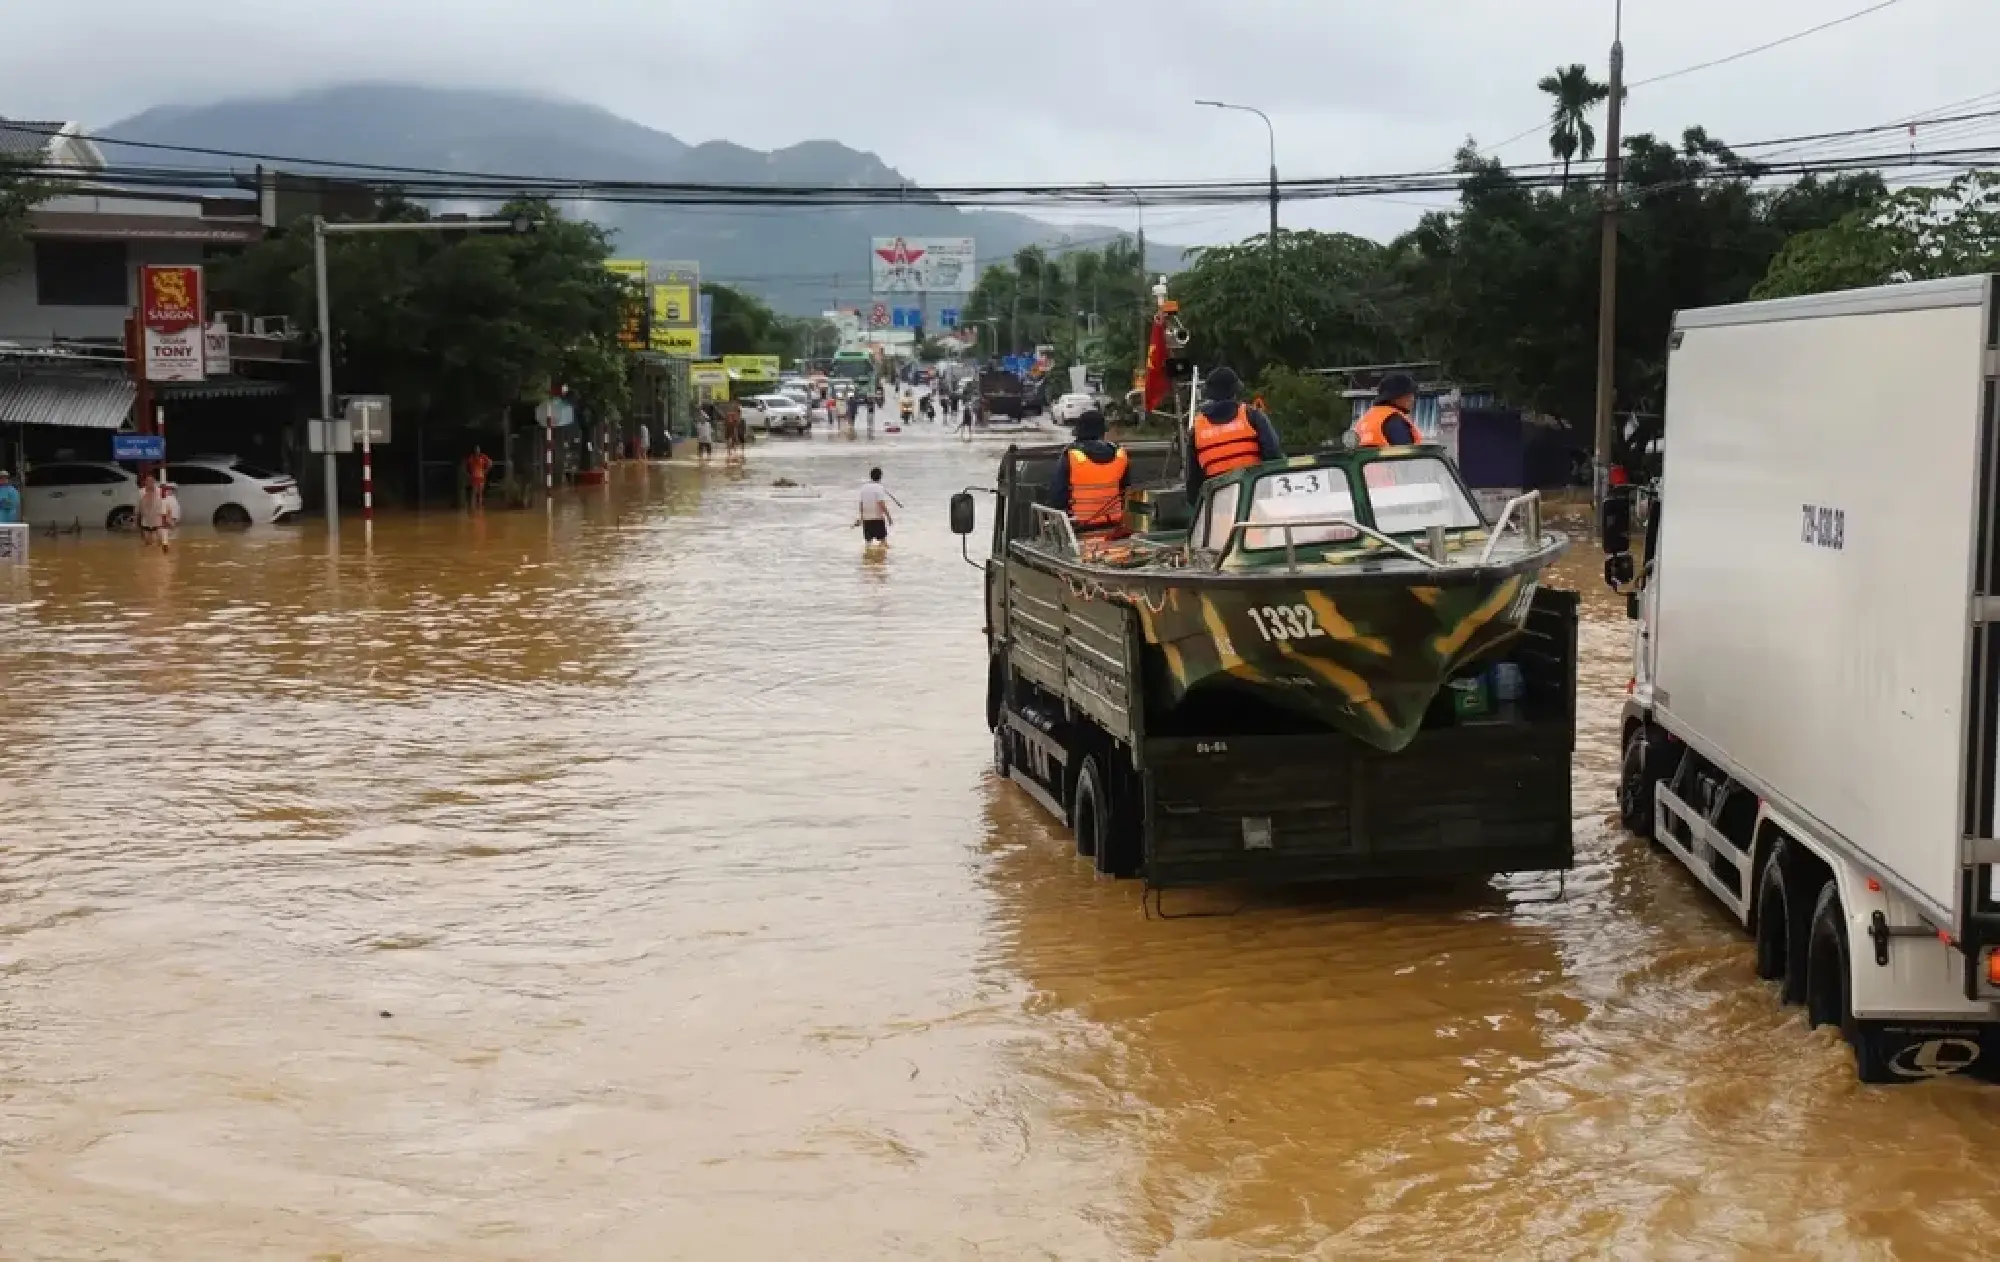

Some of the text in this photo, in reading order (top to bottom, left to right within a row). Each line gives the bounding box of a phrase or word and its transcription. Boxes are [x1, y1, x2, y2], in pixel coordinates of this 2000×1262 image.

[148, 310, 195, 321] SAIGON
[152, 345, 194, 357] TONY
[1277, 474, 1320, 496] 3-3
[1247, 603, 1325, 641] 1332
